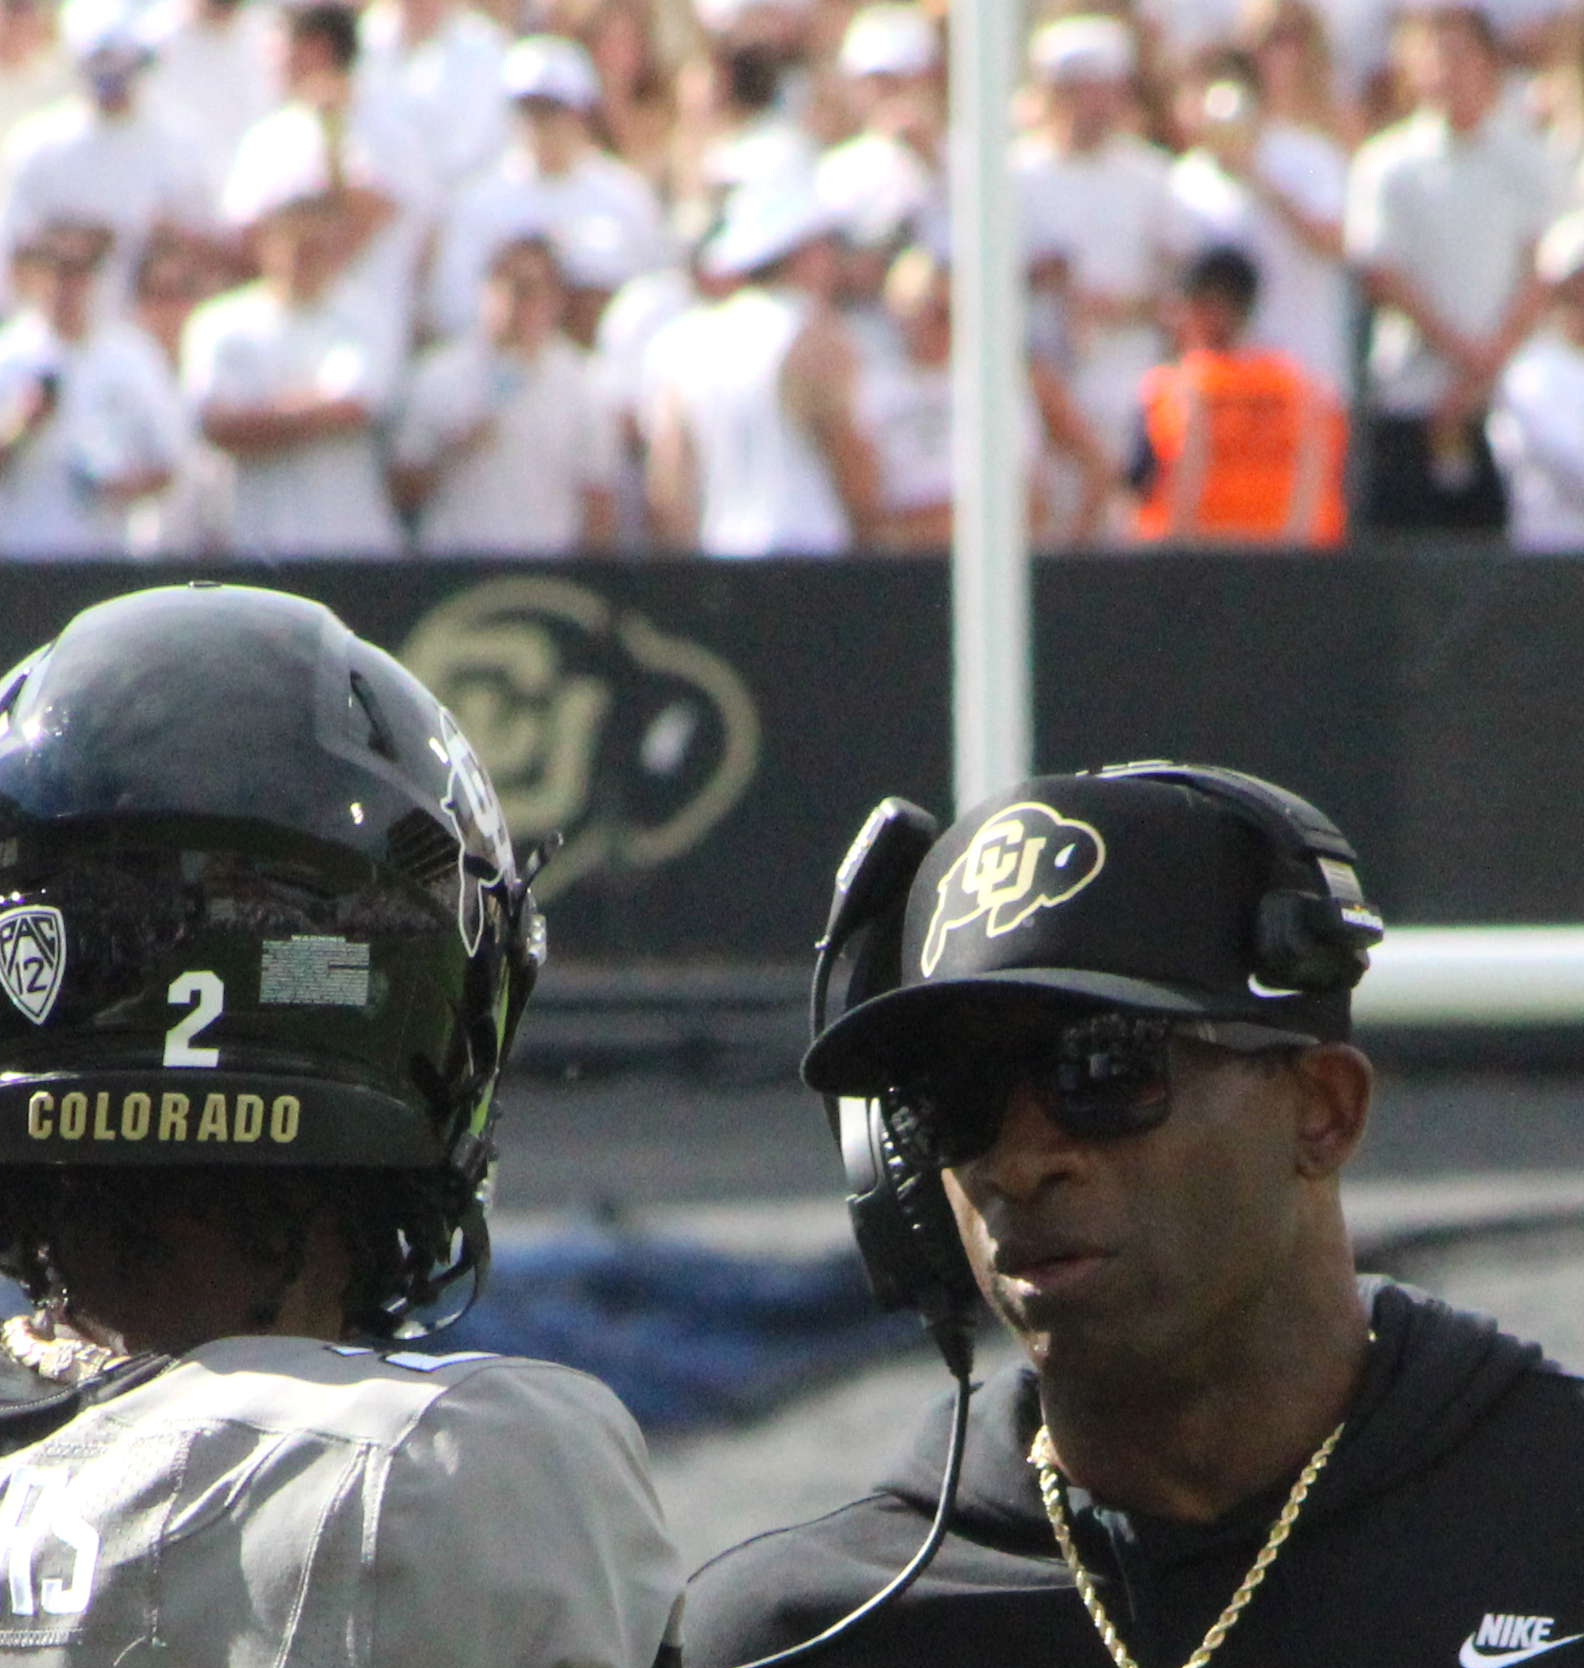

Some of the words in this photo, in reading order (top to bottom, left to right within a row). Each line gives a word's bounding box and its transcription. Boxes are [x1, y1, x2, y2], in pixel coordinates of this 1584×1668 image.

[15, 956, 49, 996] 12
[163, 969, 225, 1068] 2
[27, 1090, 302, 1144] COLORADO
[1476, 1612, 1555, 1650] NIKE
